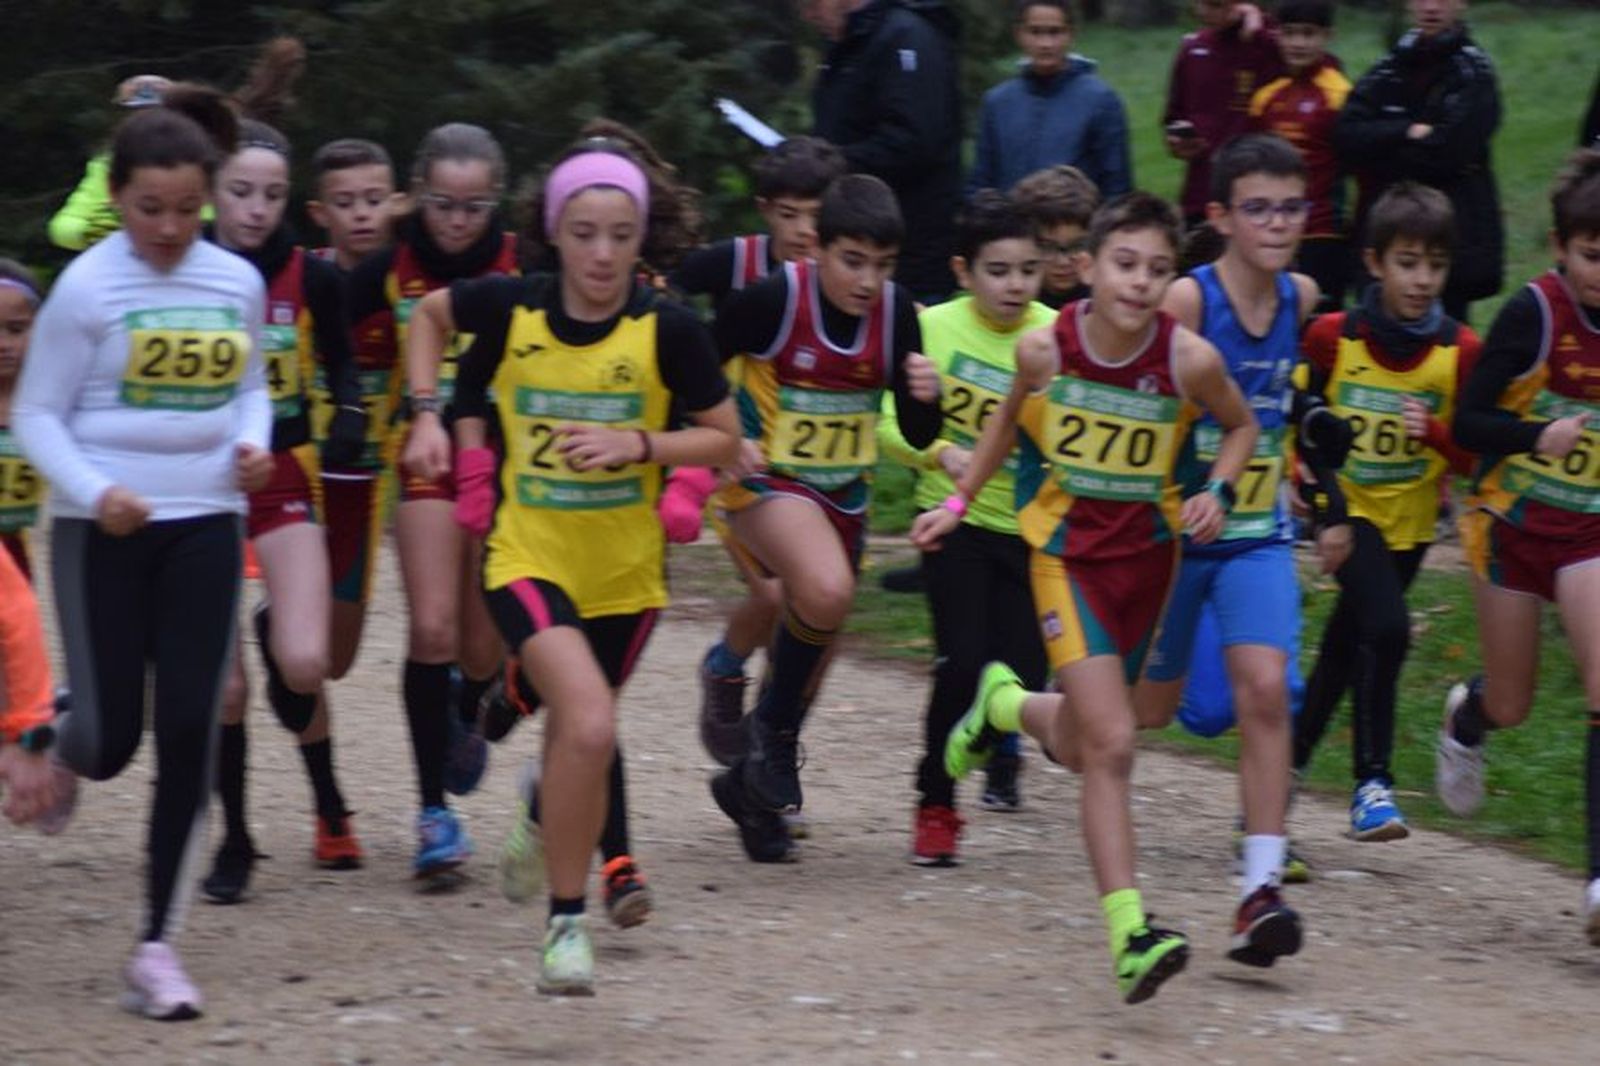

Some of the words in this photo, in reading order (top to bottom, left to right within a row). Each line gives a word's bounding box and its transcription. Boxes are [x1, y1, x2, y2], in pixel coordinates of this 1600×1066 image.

[139, 336, 238, 379] 259
[789, 419, 863, 459] 271
[1056, 413, 1157, 468] 270
